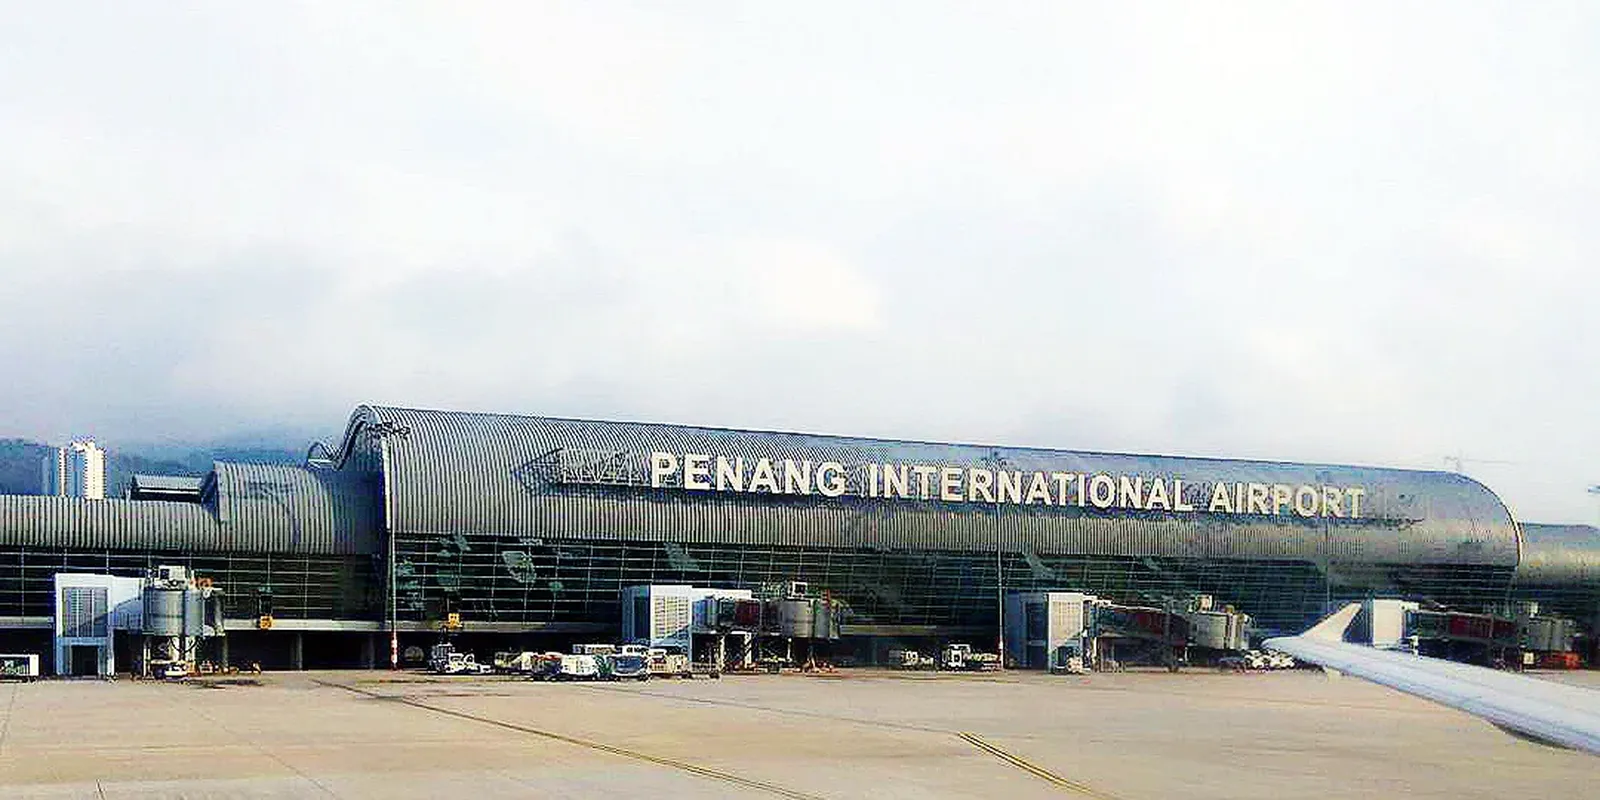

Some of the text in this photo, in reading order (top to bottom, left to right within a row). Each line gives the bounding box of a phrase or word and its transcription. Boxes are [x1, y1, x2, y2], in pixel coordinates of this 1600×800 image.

[650, 452, 1364, 518] PENANG INTERNATIONAL AIRPORT
